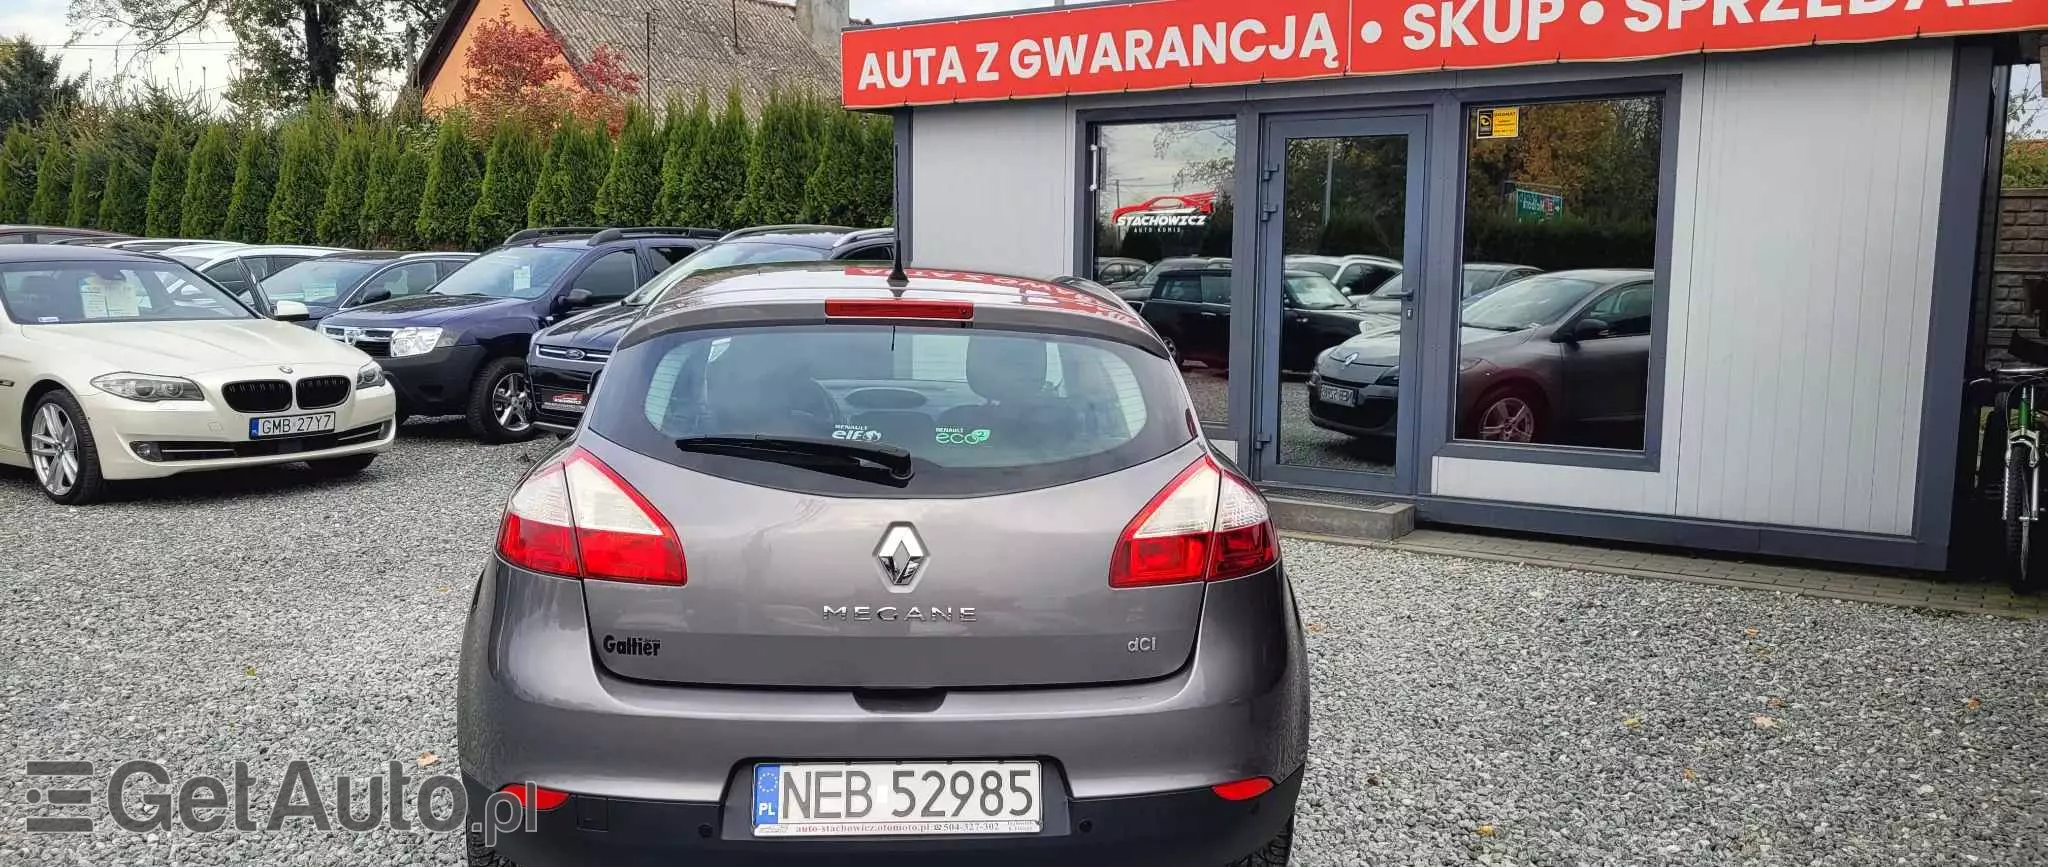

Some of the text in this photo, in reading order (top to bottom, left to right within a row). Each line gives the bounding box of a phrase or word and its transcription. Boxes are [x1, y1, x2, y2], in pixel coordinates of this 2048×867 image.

[857, 45, 966, 90] AUTA
[976, 42, 999, 81] Z
[1009, 12, 1339, 80] GWARANCJĄ
[1402, 0, 1565, 50] SKUP
[1117, 215, 1207, 226] STACHOWICZ
[263, 418, 291, 434] GMB
[297, 414, 332, 432] 27Y7
[823, 605, 977, 622] MEGANE
[603, 634, 661, 657] Galtier
[783, 769, 1033, 819] NEB 52985
[759, 803, 775, 816] PL
